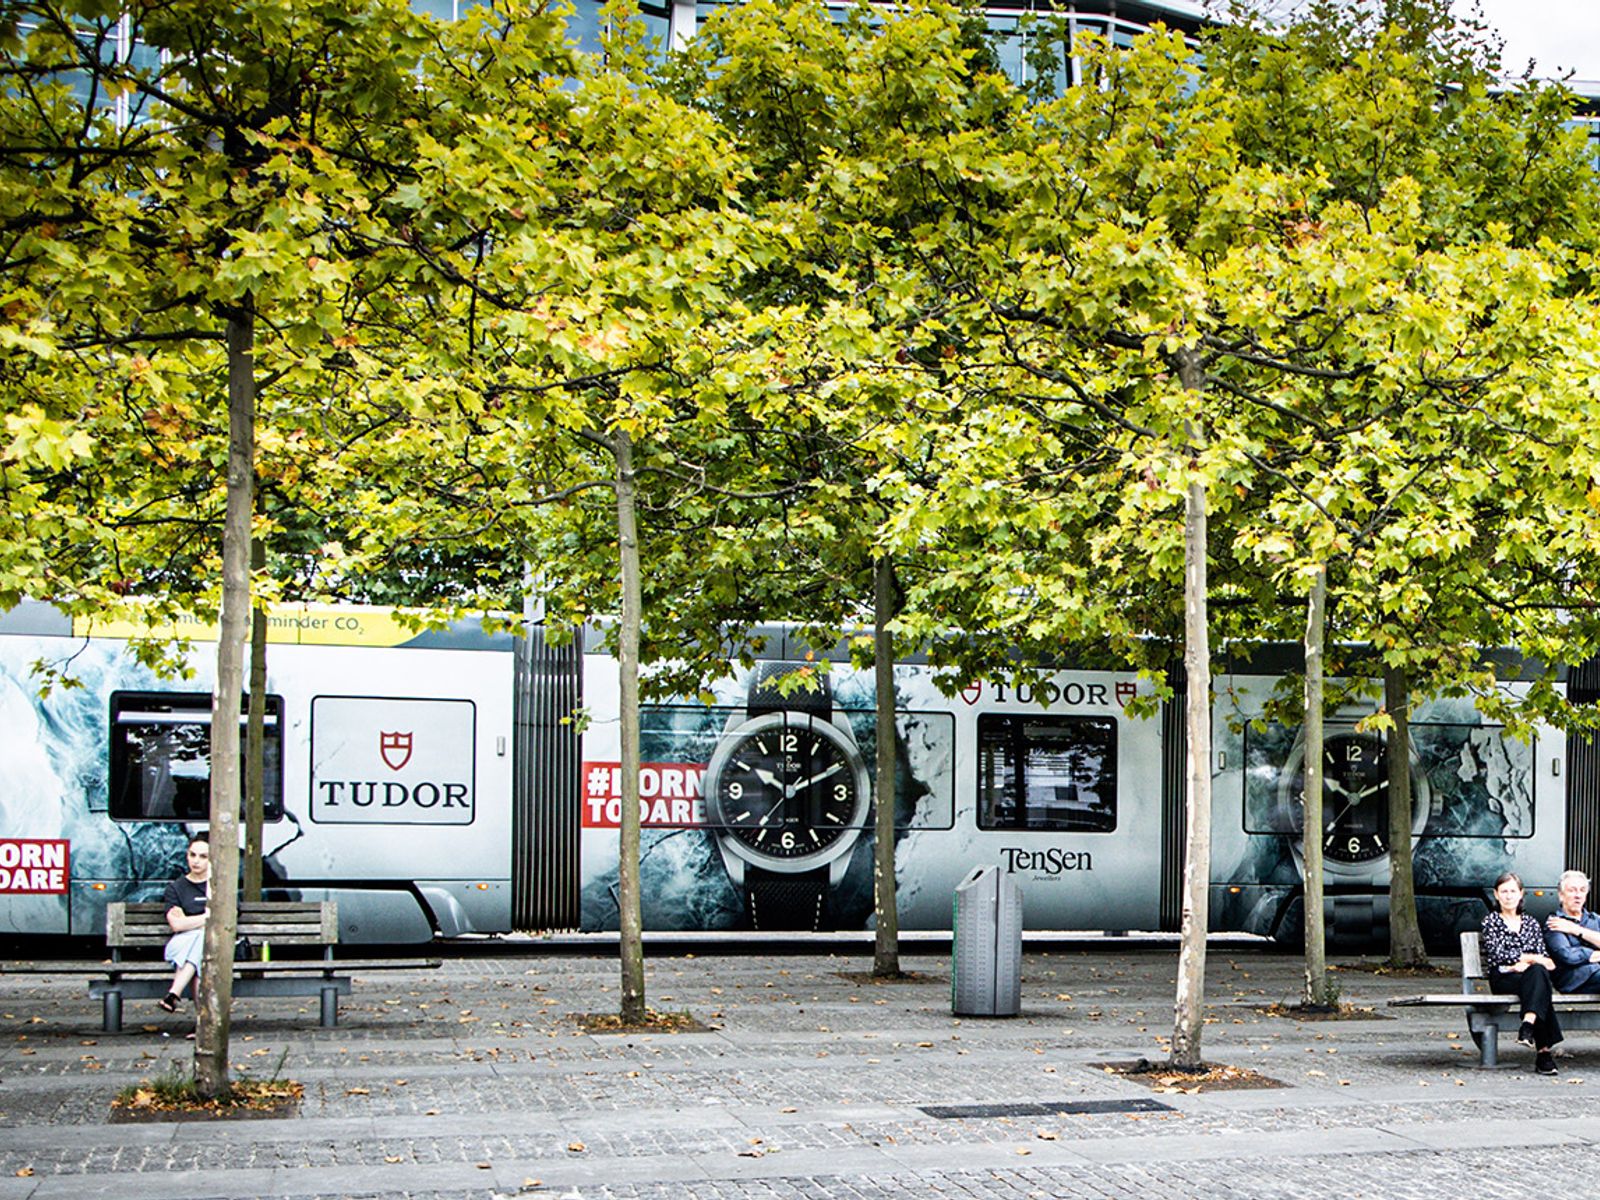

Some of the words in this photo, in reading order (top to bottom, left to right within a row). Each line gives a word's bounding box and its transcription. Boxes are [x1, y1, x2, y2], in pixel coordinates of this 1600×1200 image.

[780, 734, 798, 752] 12
[1346, 745, 1362, 762] 12
[319, 781, 470, 808] TUDOR
[728, 782, 743, 800] 9
[833, 784, 847, 801] 3
[781, 831, 795, 849] 6
[1348, 837, 1361, 853] 6
[1000, 847, 1093, 875] TenSen
